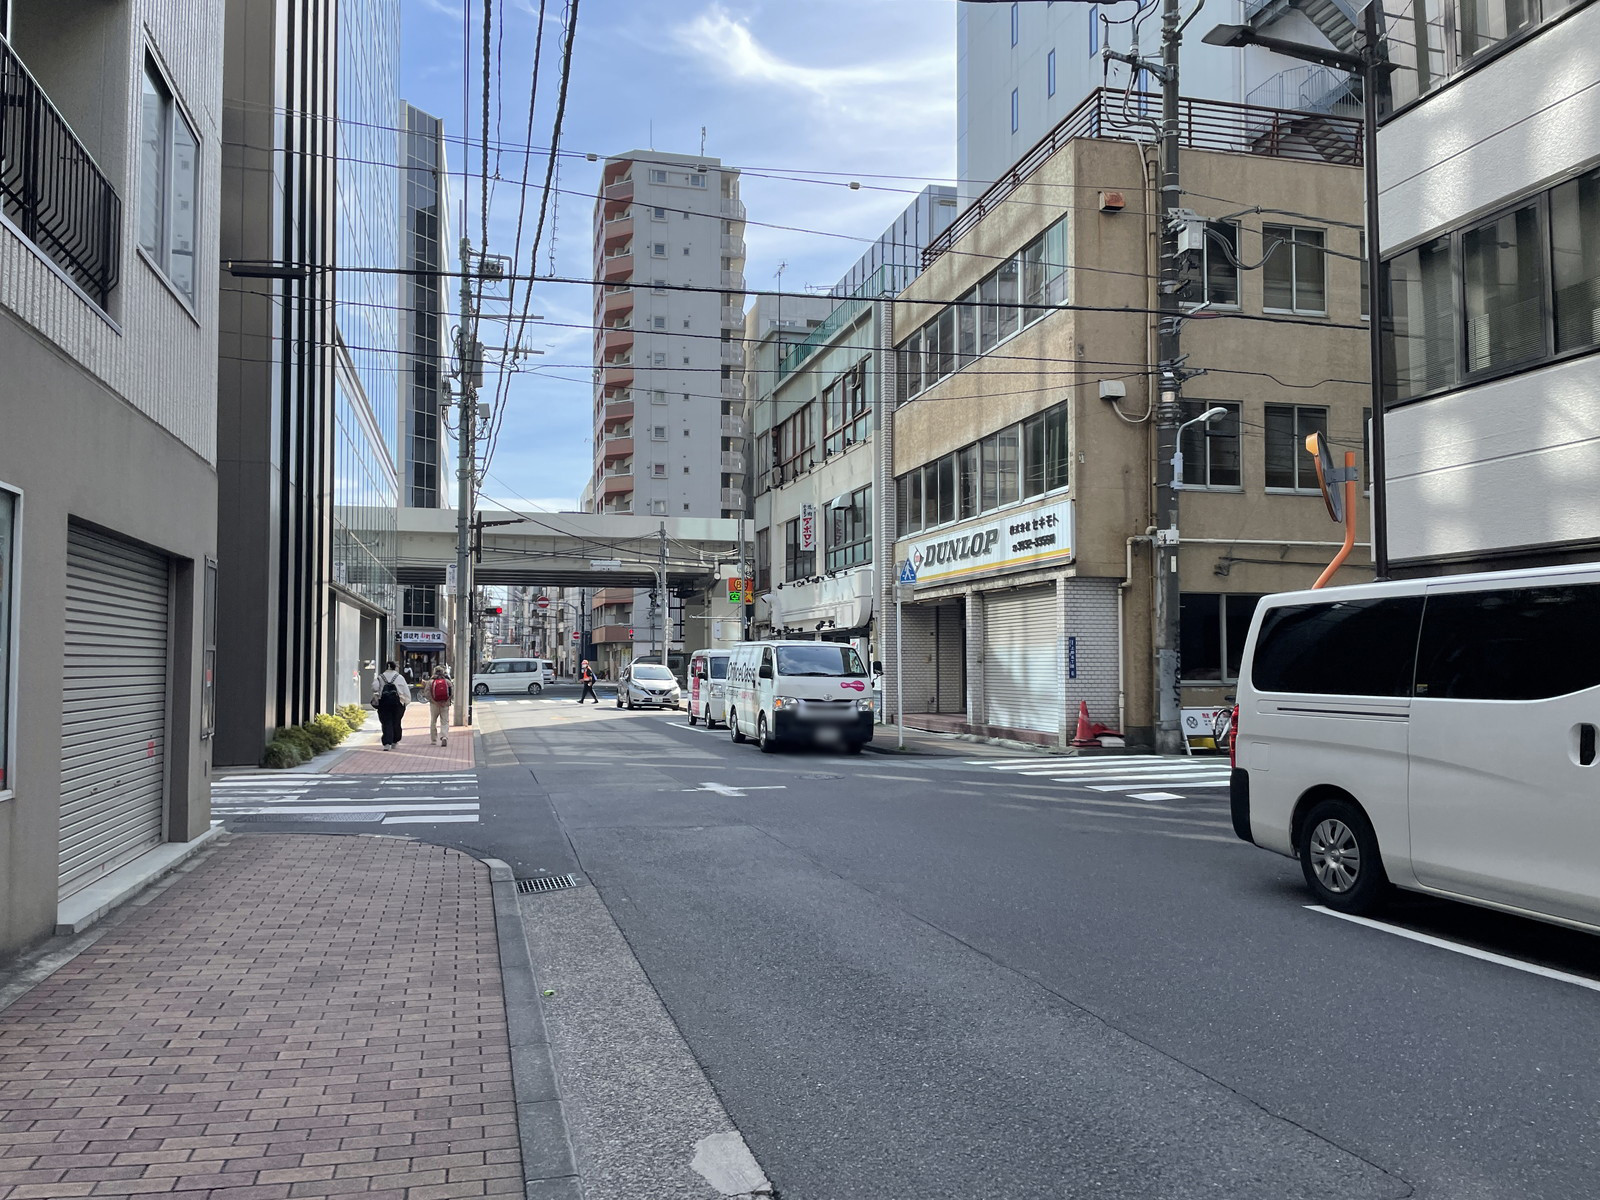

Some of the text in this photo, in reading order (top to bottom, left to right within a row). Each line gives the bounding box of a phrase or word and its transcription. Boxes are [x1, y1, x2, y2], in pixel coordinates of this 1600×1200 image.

[803, 518, 812, 548] アポロン
[924, 528, 999, 567] DUNLOP
